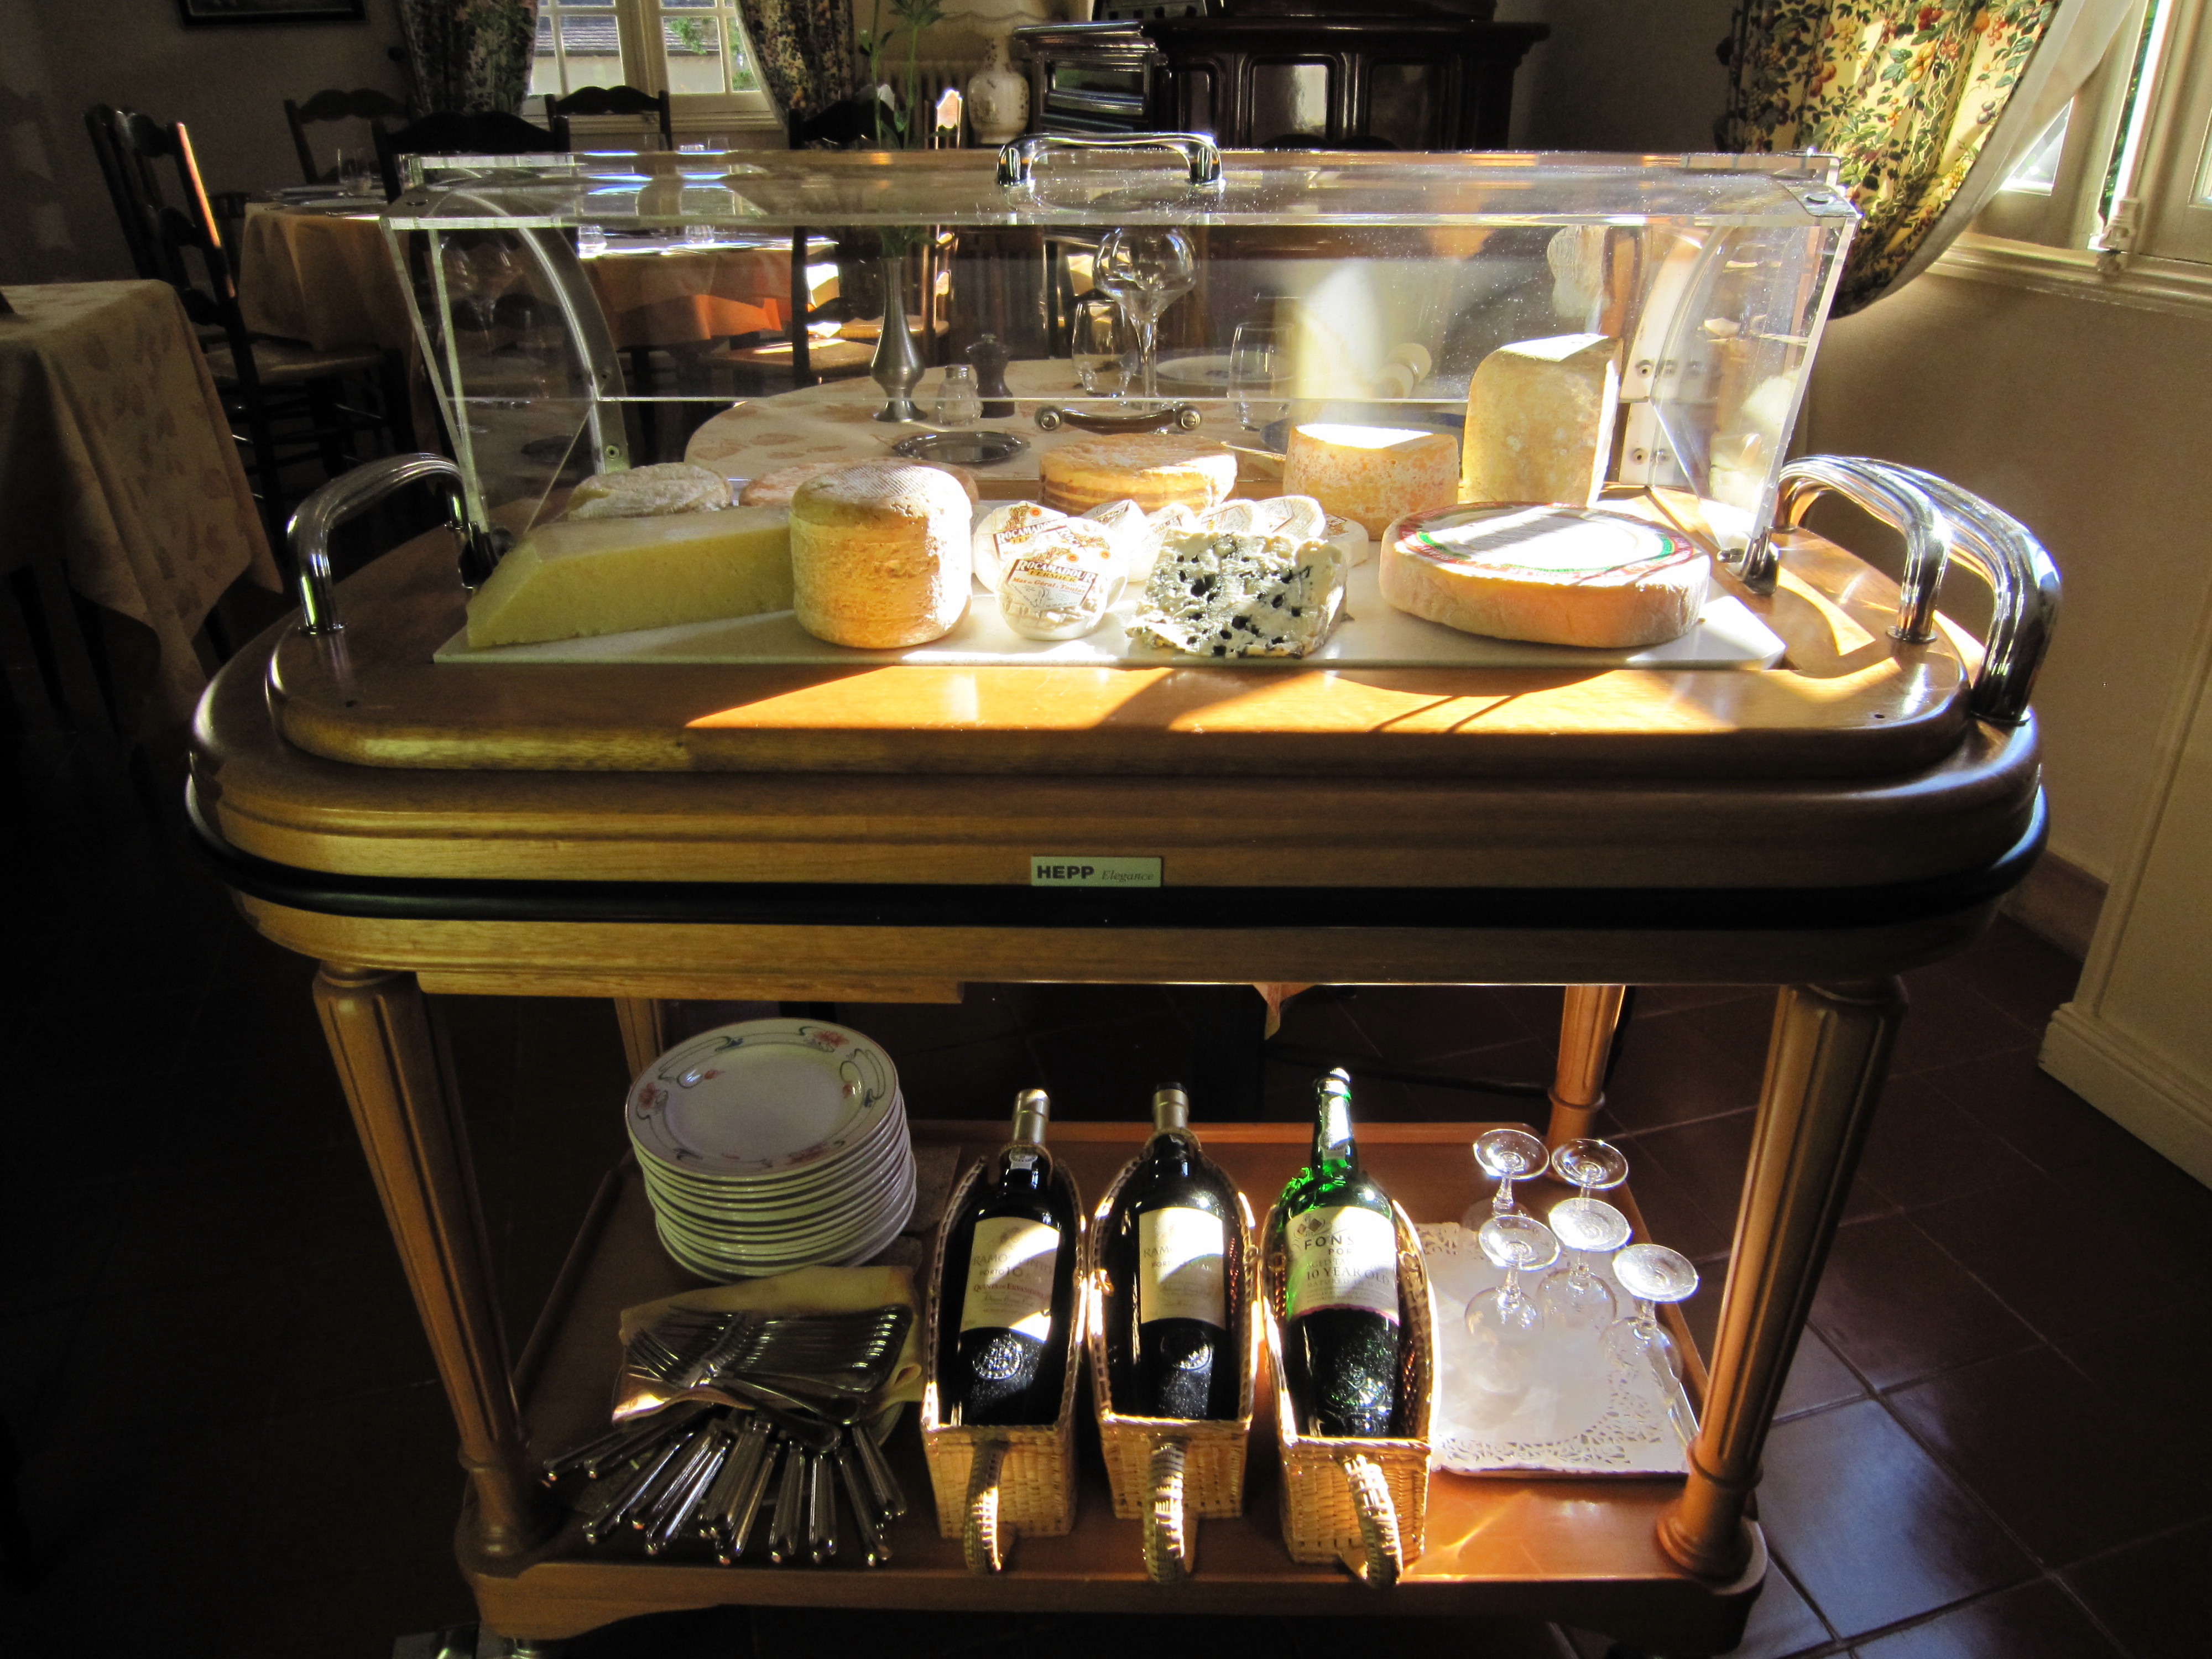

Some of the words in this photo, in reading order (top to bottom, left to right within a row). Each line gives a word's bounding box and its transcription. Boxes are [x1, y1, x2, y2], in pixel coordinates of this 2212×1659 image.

[1015, 560, 1095, 583] ROCAMADOUR
[1030, 570, 1076, 583] FERMIER
[1037, 865, 1094, 879] HEPP
[1102, 869, 1154, 883] Elegance
[1305, 1235, 1354, 1250] FONS
[1144, 1245, 1172, 1258] RAM
[1307, 1269, 1319, 1280] 10
[1323, 1266, 1362, 1277] YEAR
[1364, 1269, 1390, 1285] OLD
